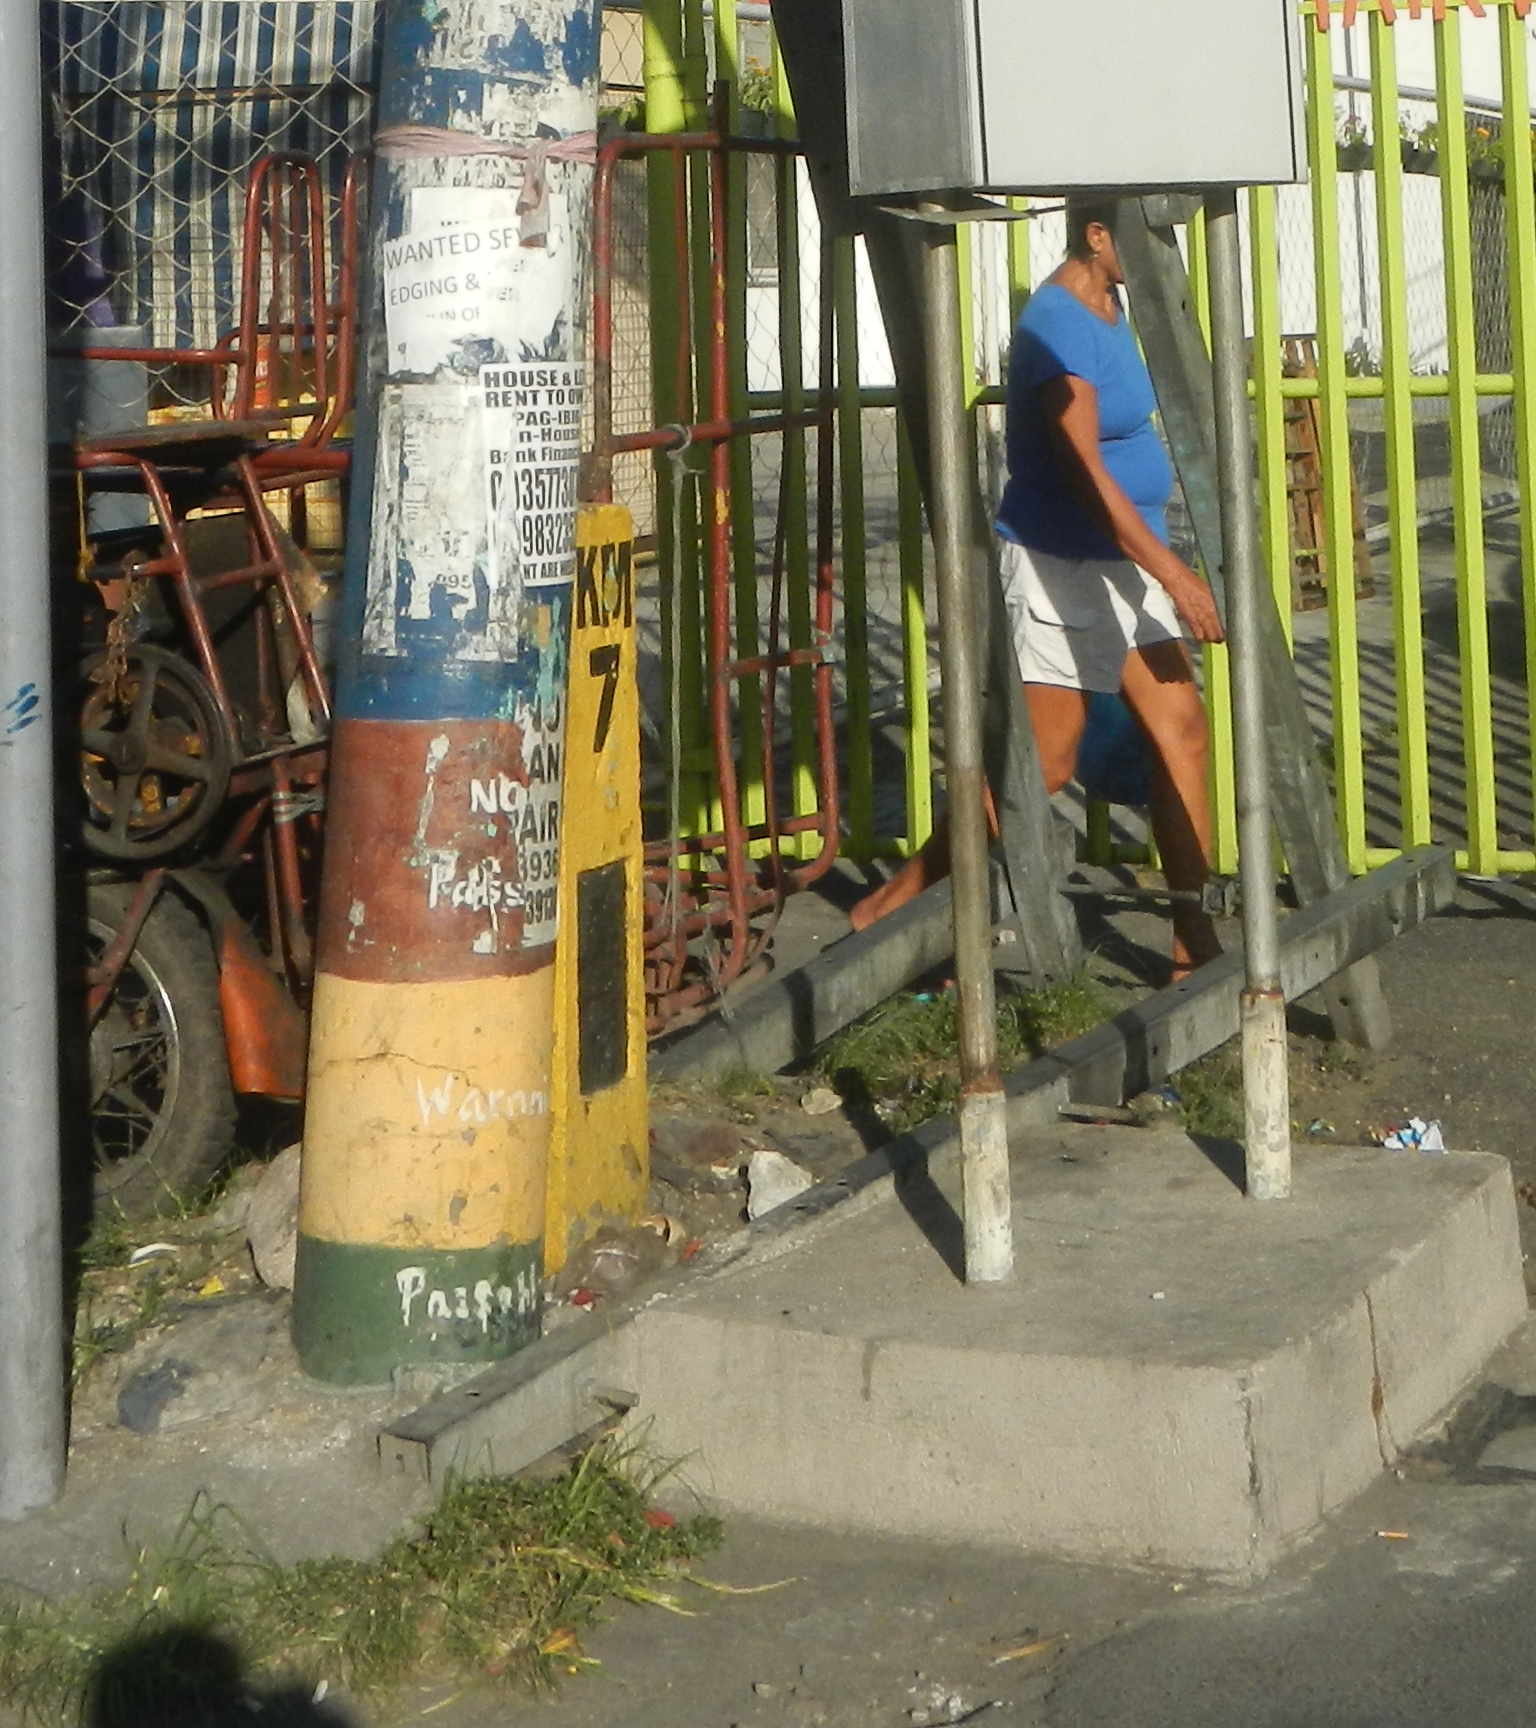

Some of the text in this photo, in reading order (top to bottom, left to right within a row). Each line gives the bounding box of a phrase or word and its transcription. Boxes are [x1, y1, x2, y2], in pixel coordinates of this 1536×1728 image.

[385, 232, 481, 270] WANTED
[390, 276, 458, 306] EDGING
[465, 273, 481, 291] &
[484, 370, 557, 388] HOUSE
[562, 372, 570, 386] &
[486, 390, 541, 408] RENT
[548, 389, 565, 406] TO
[576, 541, 632, 629] KM
[589, 644, 621, 752] 7
